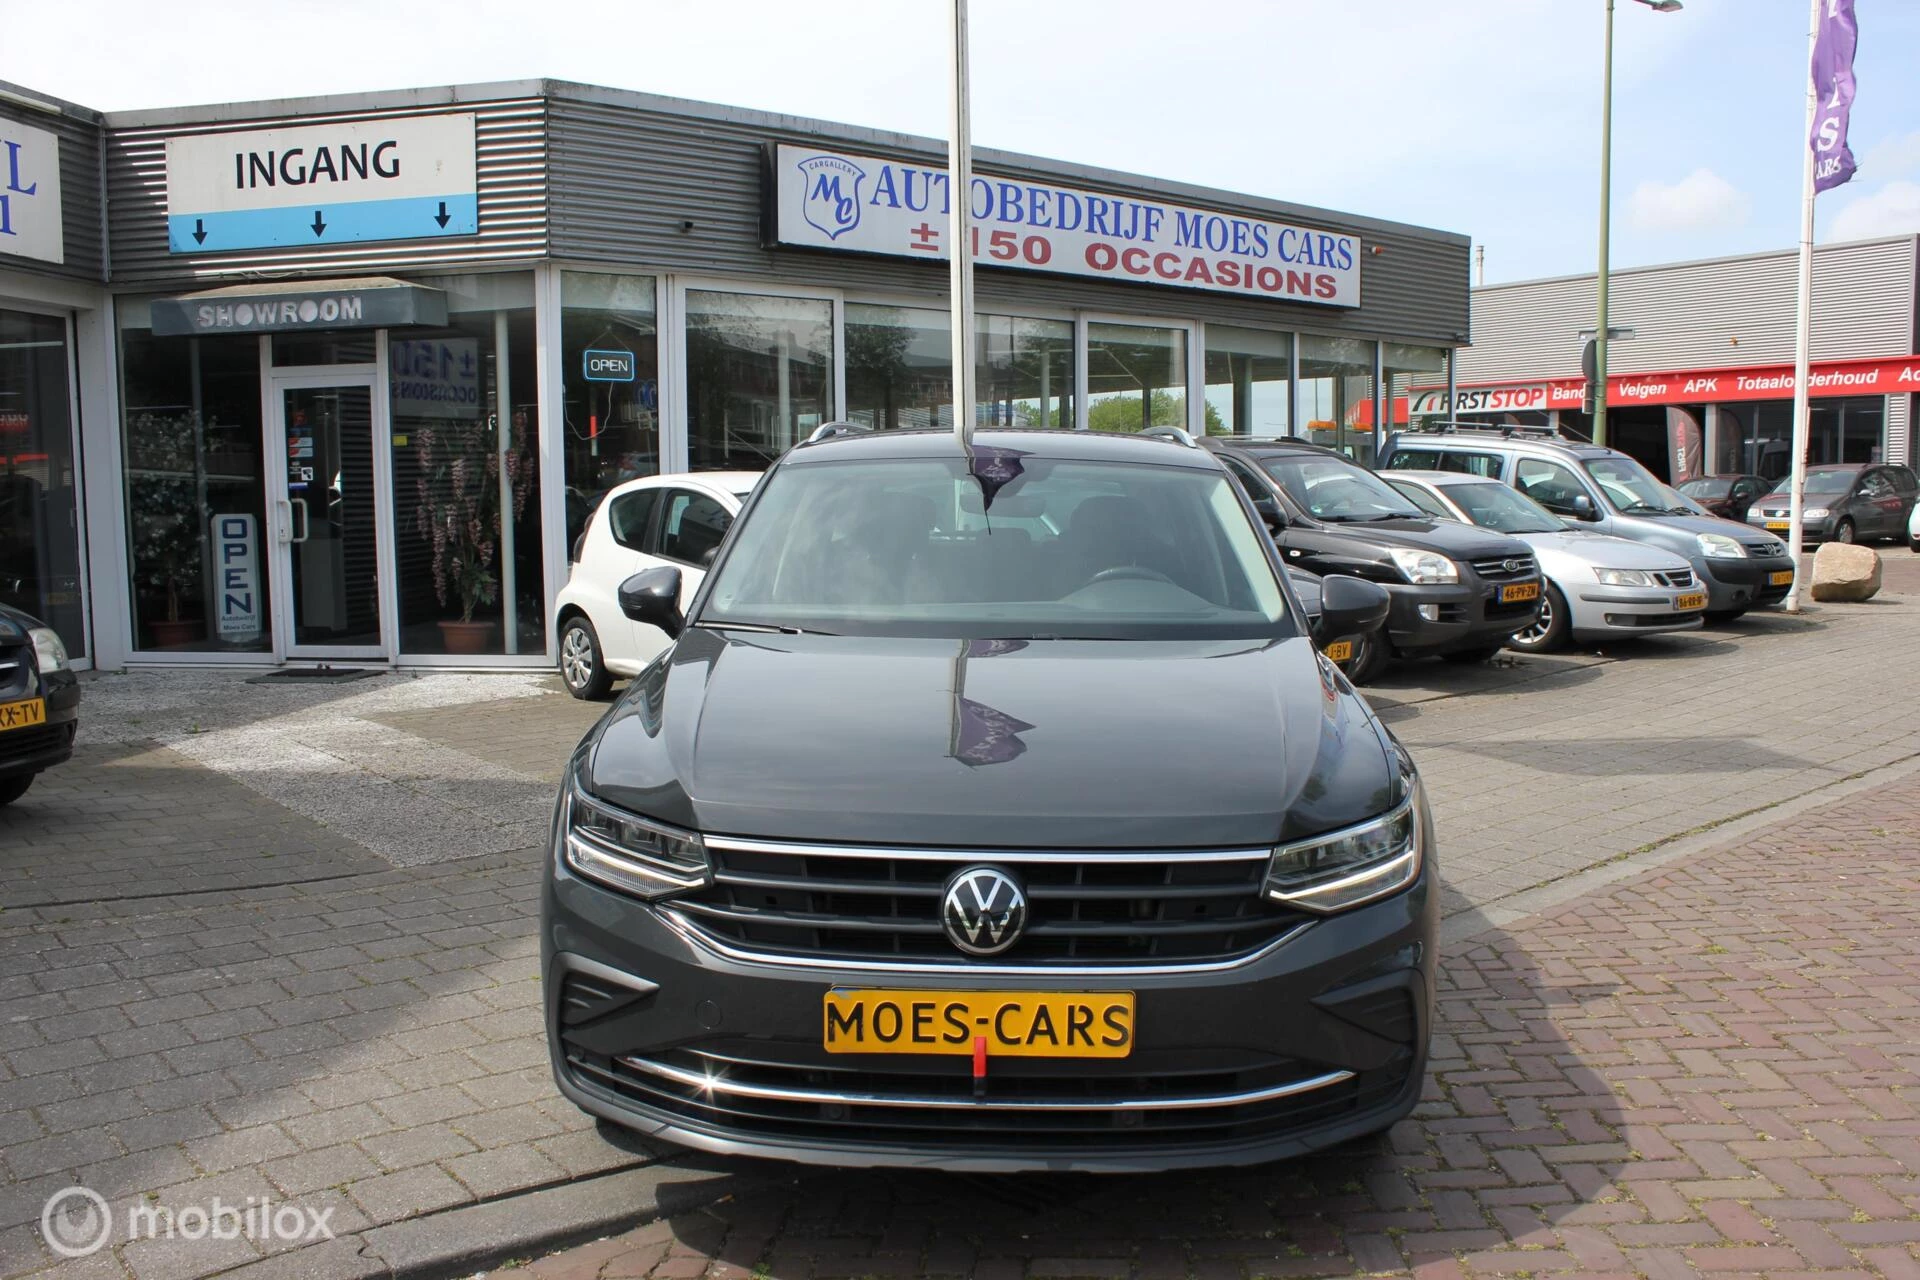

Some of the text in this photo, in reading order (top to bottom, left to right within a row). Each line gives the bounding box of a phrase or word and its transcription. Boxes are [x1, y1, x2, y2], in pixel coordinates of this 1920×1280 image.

[235, 140, 400, 189] INGANG
[808, 160, 857, 177] CARGALLERY
[869, 165, 1353, 271] AUTOBEDRIJF MOES CARS
[1084, 242, 1337, 299] OCCASIONS
[197, 295, 362, 328] SHOWROOM
[590, 359, 629, 372] OPEN
[1439, 387, 1544, 411] FRSTSTOP
[1619, 382, 1667, 399] Velgen
[1683, 377, 1718, 394] APK
[1736, 369, 1879, 391] Totaaloderhoud
[222, 518, 252, 615] OPEN
[826, 1001, 1130, 1047] MOES-CARS
